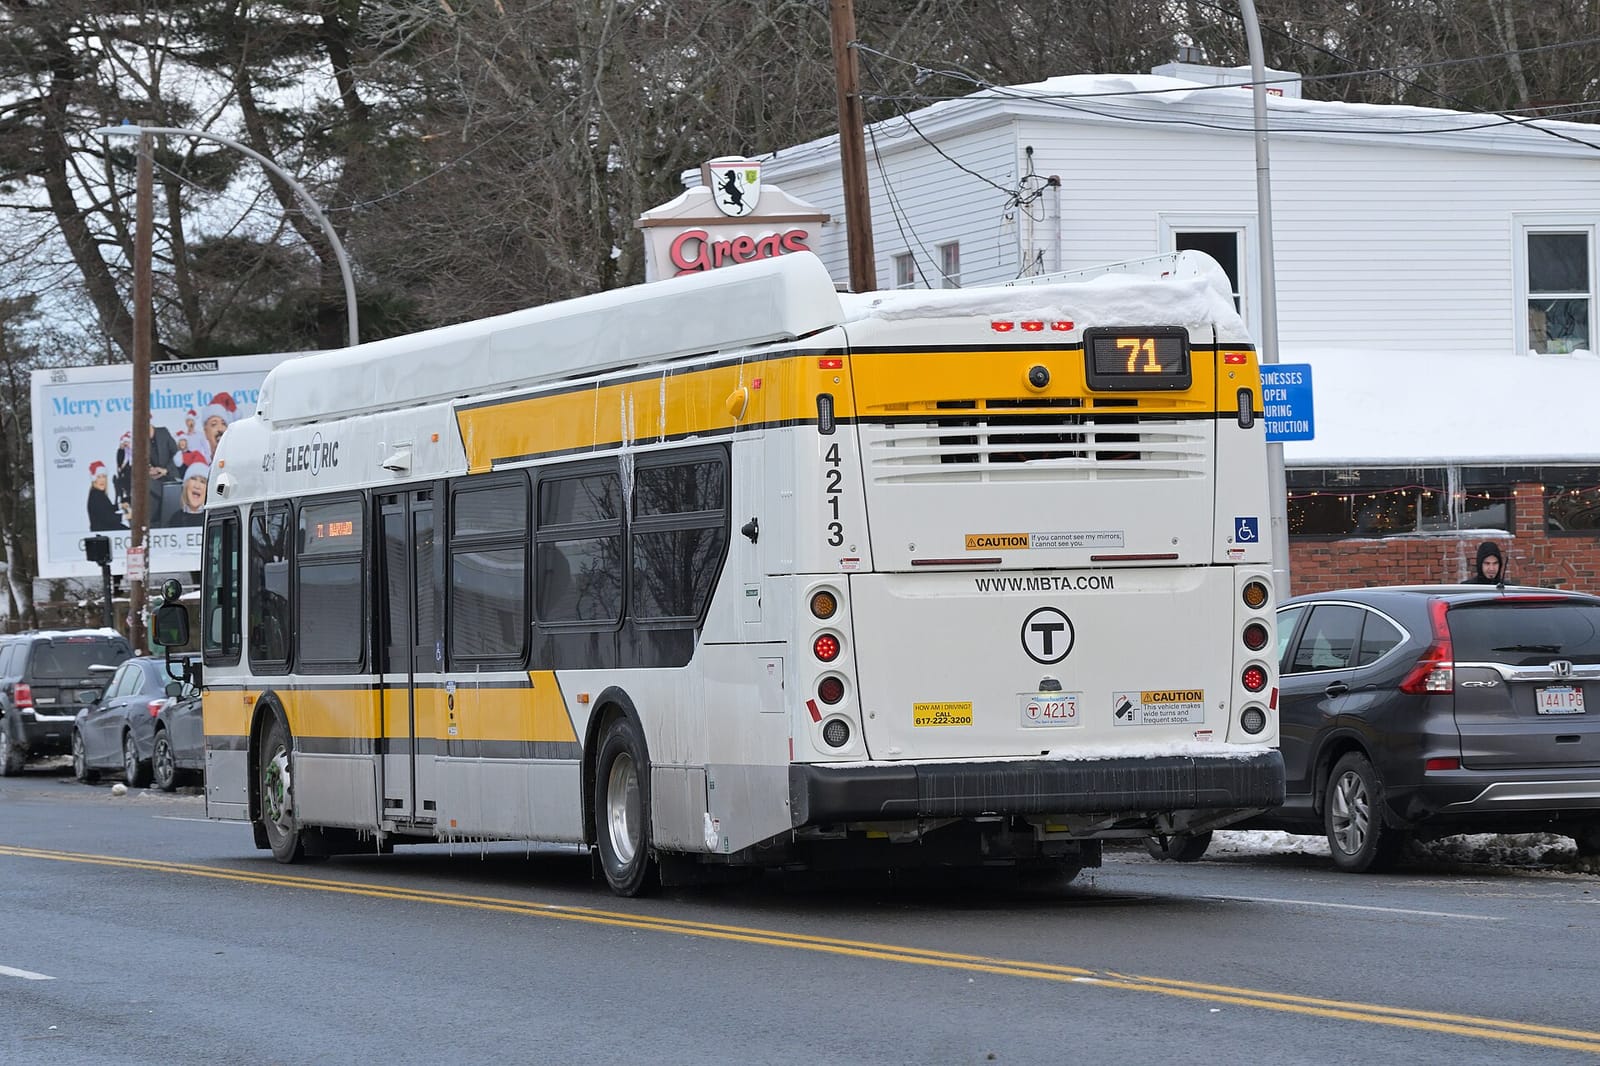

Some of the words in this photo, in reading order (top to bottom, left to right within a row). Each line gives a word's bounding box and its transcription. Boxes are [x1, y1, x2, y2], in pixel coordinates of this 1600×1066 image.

[1115, 337, 1162, 374] 71
[1259, 371, 1303, 385] SINESSES
[1263, 388, 1287, 401] OPEN
[52, 396, 101, 418] Merry
[105, 388, 194, 412] evething
[196, 388, 213, 407] to
[232, 387, 260, 405] eve
[1264, 404, 1292, 418] URING
[1264, 420, 1309, 434] STRUCTION
[285, 440, 339, 473] ELECTRIC
[824, 442, 844, 547] 4213
[114, 534, 181, 550] RORTS,
[976, 536, 1028, 547] CAUTION
[974, 575, 1115, 592] WWW.MBTA.COM
[1152, 691, 1202, 702] CAUTION
[1043, 702, 1076, 718] 4213
[915, 716, 971, 725] 617-222-3200
